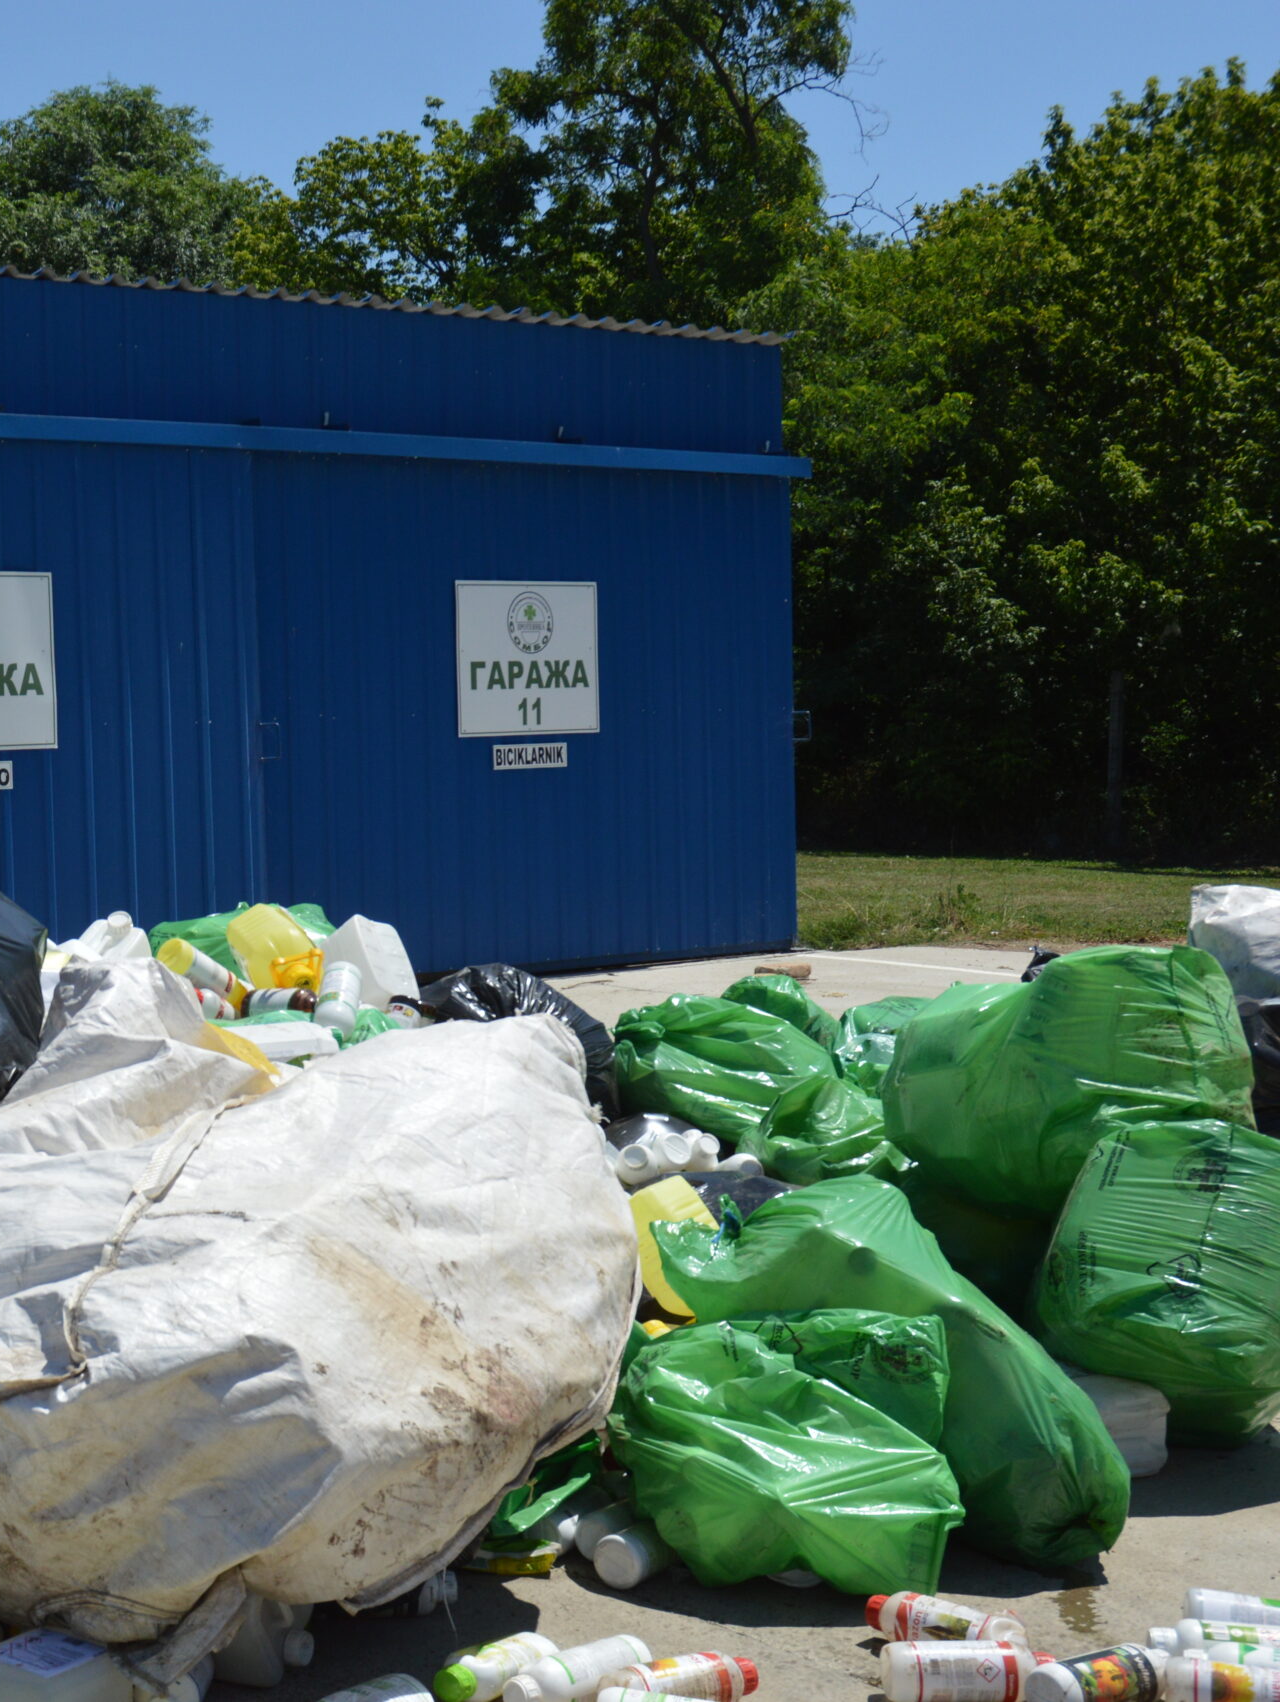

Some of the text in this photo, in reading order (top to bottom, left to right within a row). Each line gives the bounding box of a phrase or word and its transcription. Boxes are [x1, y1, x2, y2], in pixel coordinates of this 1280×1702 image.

[470, 660, 589, 690] ГАРАЖА
[518, 697, 541, 726] 11
[495, 746, 564, 767] BICIKLARNIK
